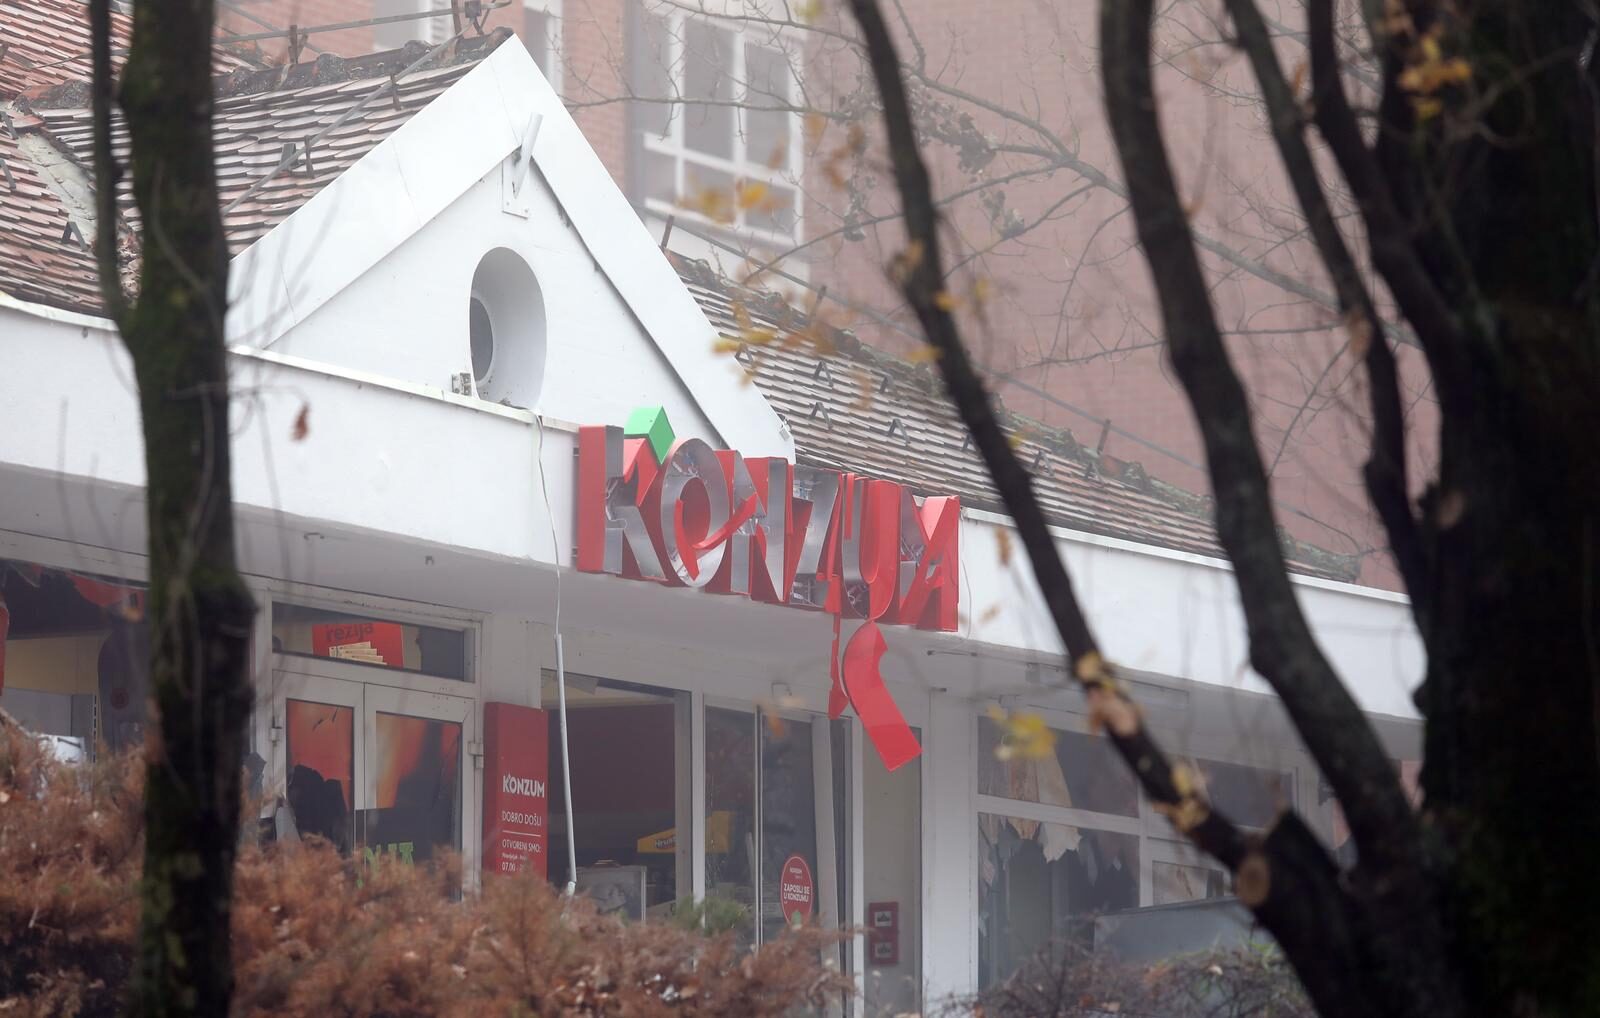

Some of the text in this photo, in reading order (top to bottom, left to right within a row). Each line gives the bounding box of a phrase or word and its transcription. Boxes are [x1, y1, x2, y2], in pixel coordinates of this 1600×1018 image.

[576, 406, 960, 632] KONZUM
[503, 774, 545, 798] KONZUM
[502, 811, 542, 826] DOBRO DOŠLI
[502, 839, 527, 850] OTVORENI
[784, 883, 810, 894] ZAPOSLI SE
[788, 893, 808, 902] KONZUMU
